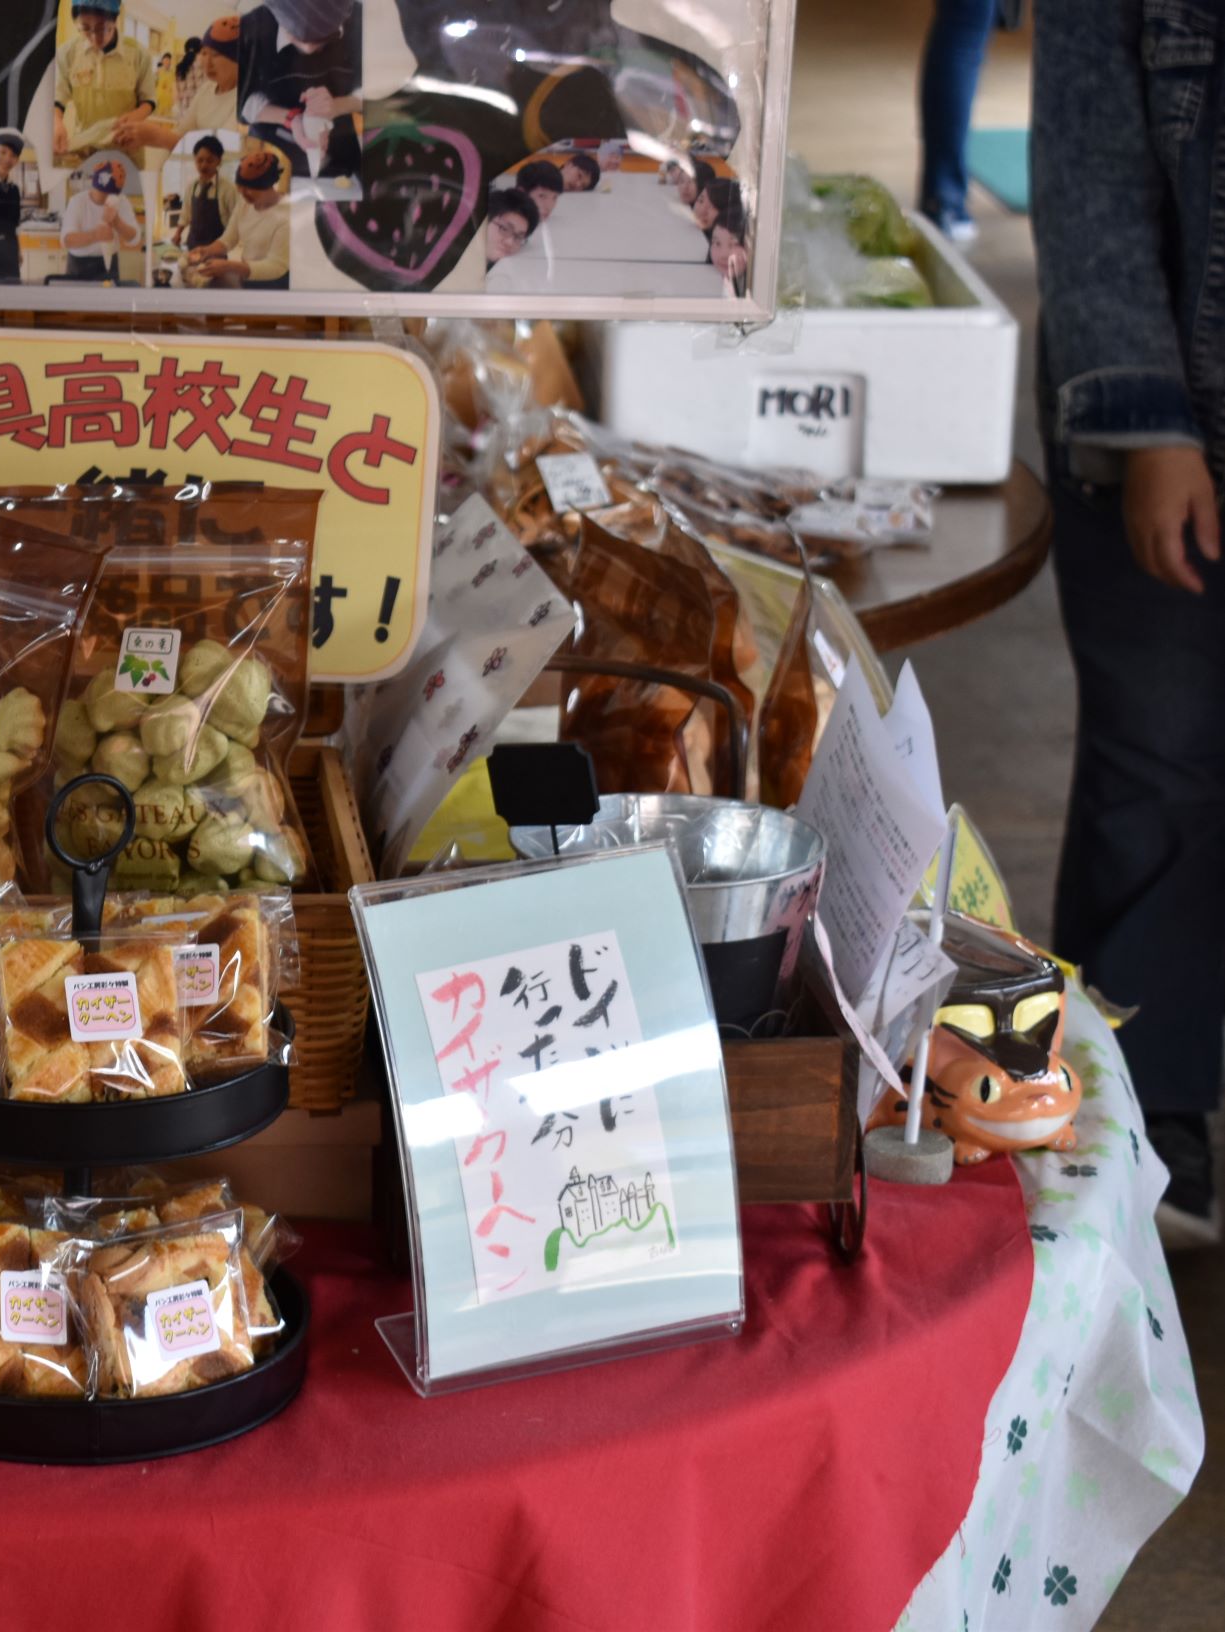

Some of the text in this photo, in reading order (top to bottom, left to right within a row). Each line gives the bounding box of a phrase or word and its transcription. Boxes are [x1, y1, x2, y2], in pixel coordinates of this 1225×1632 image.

[758, 384, 851, 420] MORI
[76, 994, 131, 1010] カイザー
[79, 1010, 133, 1025] クーヘン
[500, 967, 579, 1150] 行った分
[430, 971, 536, 1291] カイザクーヘン
